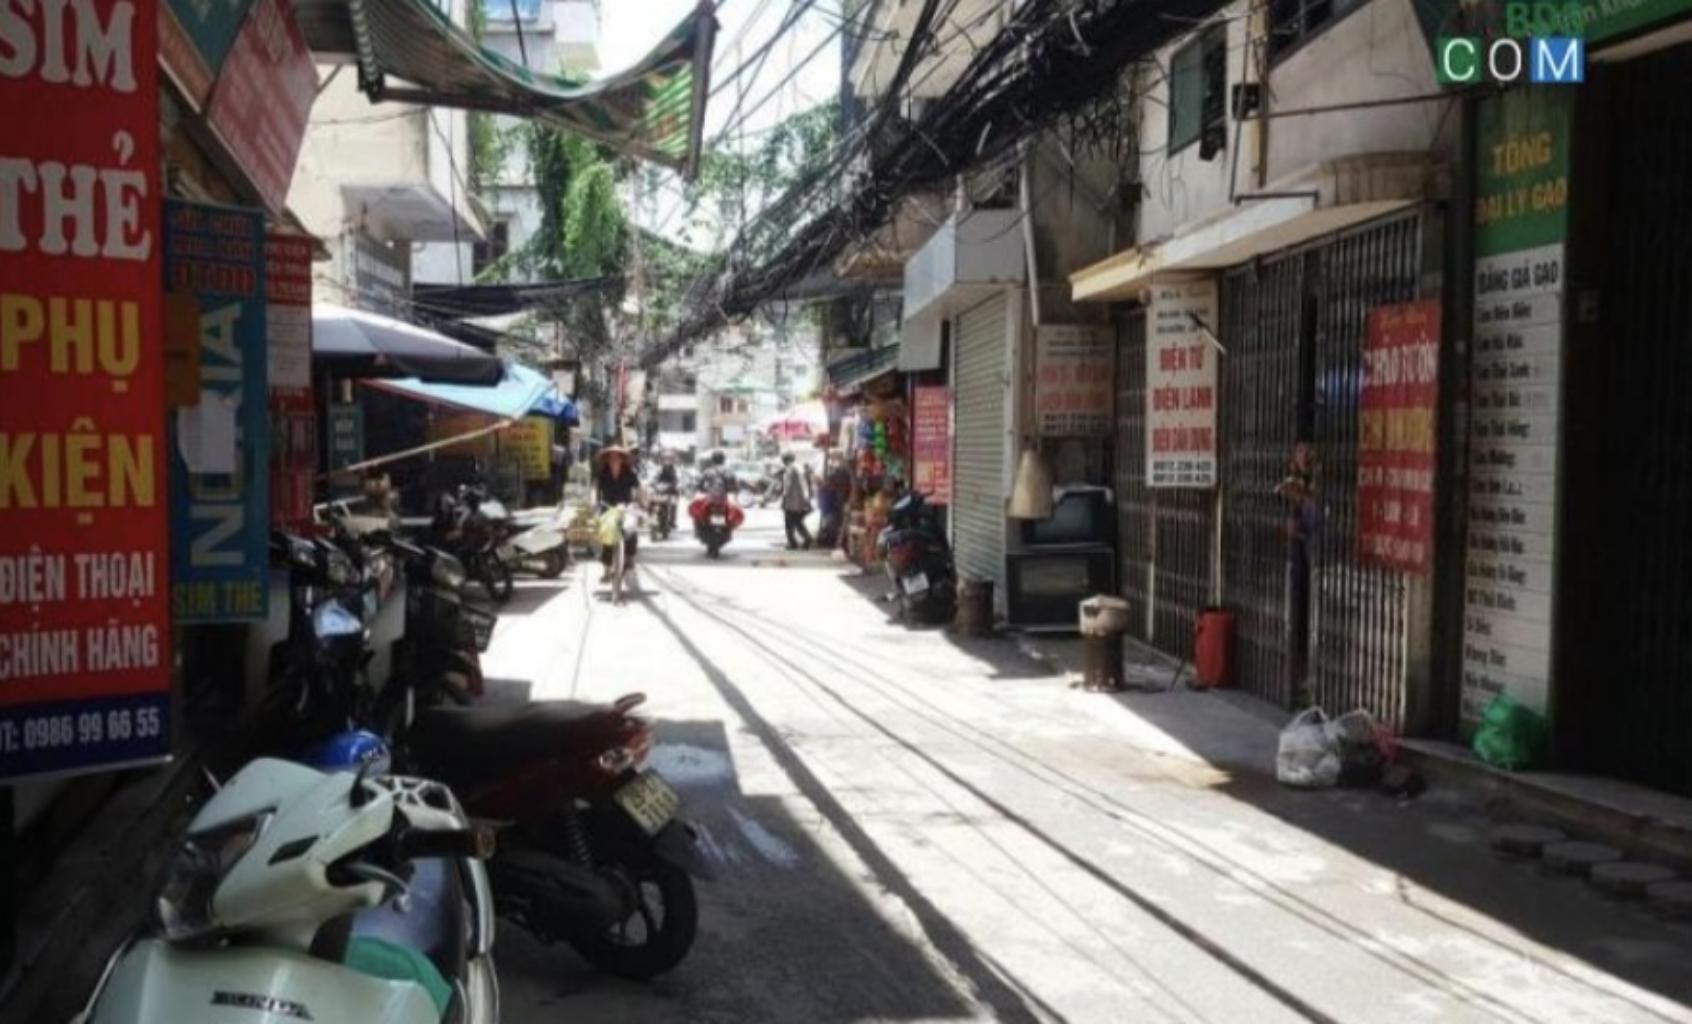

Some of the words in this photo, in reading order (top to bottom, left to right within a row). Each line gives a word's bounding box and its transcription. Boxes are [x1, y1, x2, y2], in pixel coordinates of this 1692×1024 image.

[0, 0, 138, 93] SIM
[0, 130, 150, 261] THẺ
[2, 293, 140, 392] PHỤ
[0, 417, 155, 524] KIỆN
[0, 545, 66, 611] ĐIỆN
[76, 552, 155, 607] THOẠI
[0, 622, 79, 678] CHÍNH
[24, 714, 72, 750] 0986
[79, 712, 103, 743] 99
[107, 710, 131, 741] 66
[137, 706, 160, 737] 55
